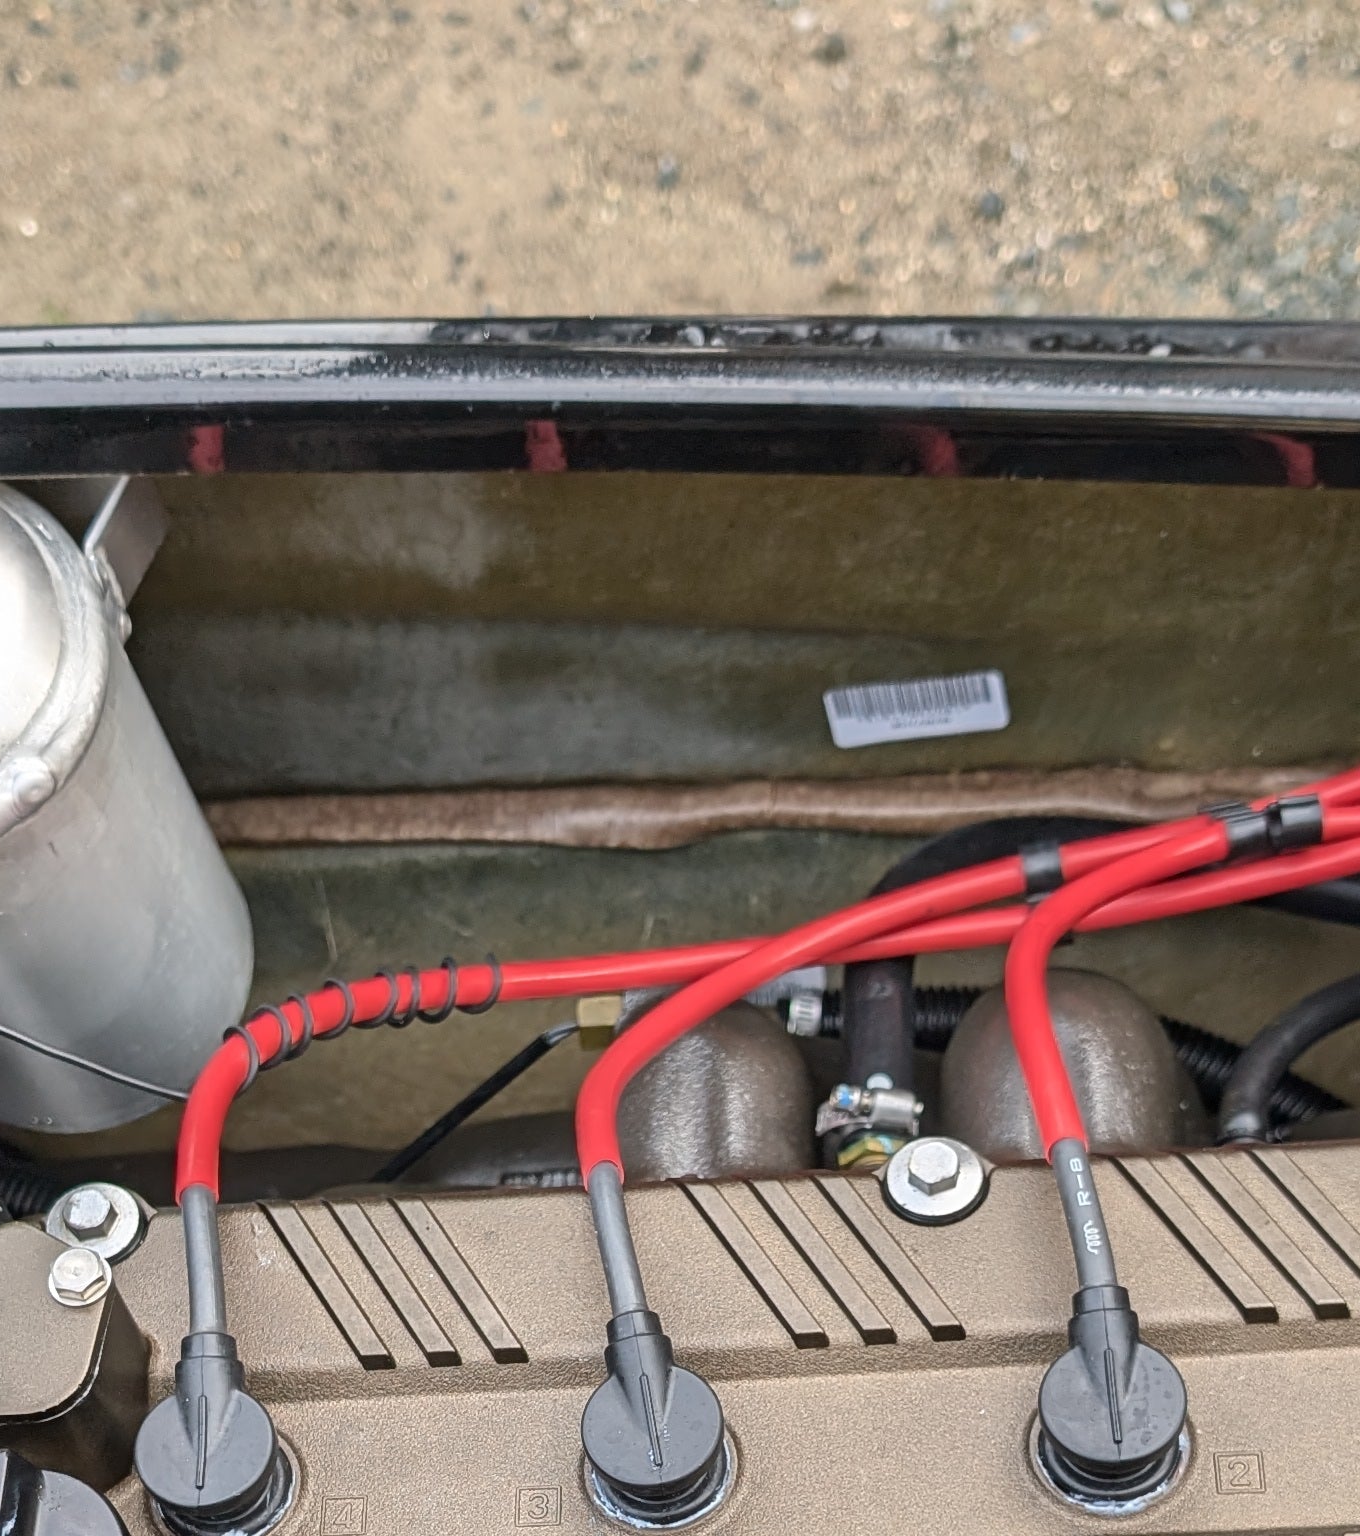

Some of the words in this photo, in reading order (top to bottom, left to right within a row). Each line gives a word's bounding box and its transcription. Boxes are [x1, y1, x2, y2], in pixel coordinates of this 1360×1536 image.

[1070, 1157, 1093, 1207] R-8
[1227, 1460, 1251, 1488] 2
[332, 1502, 354, 1529] 4
[527, 1493, 550, 1520] 3
